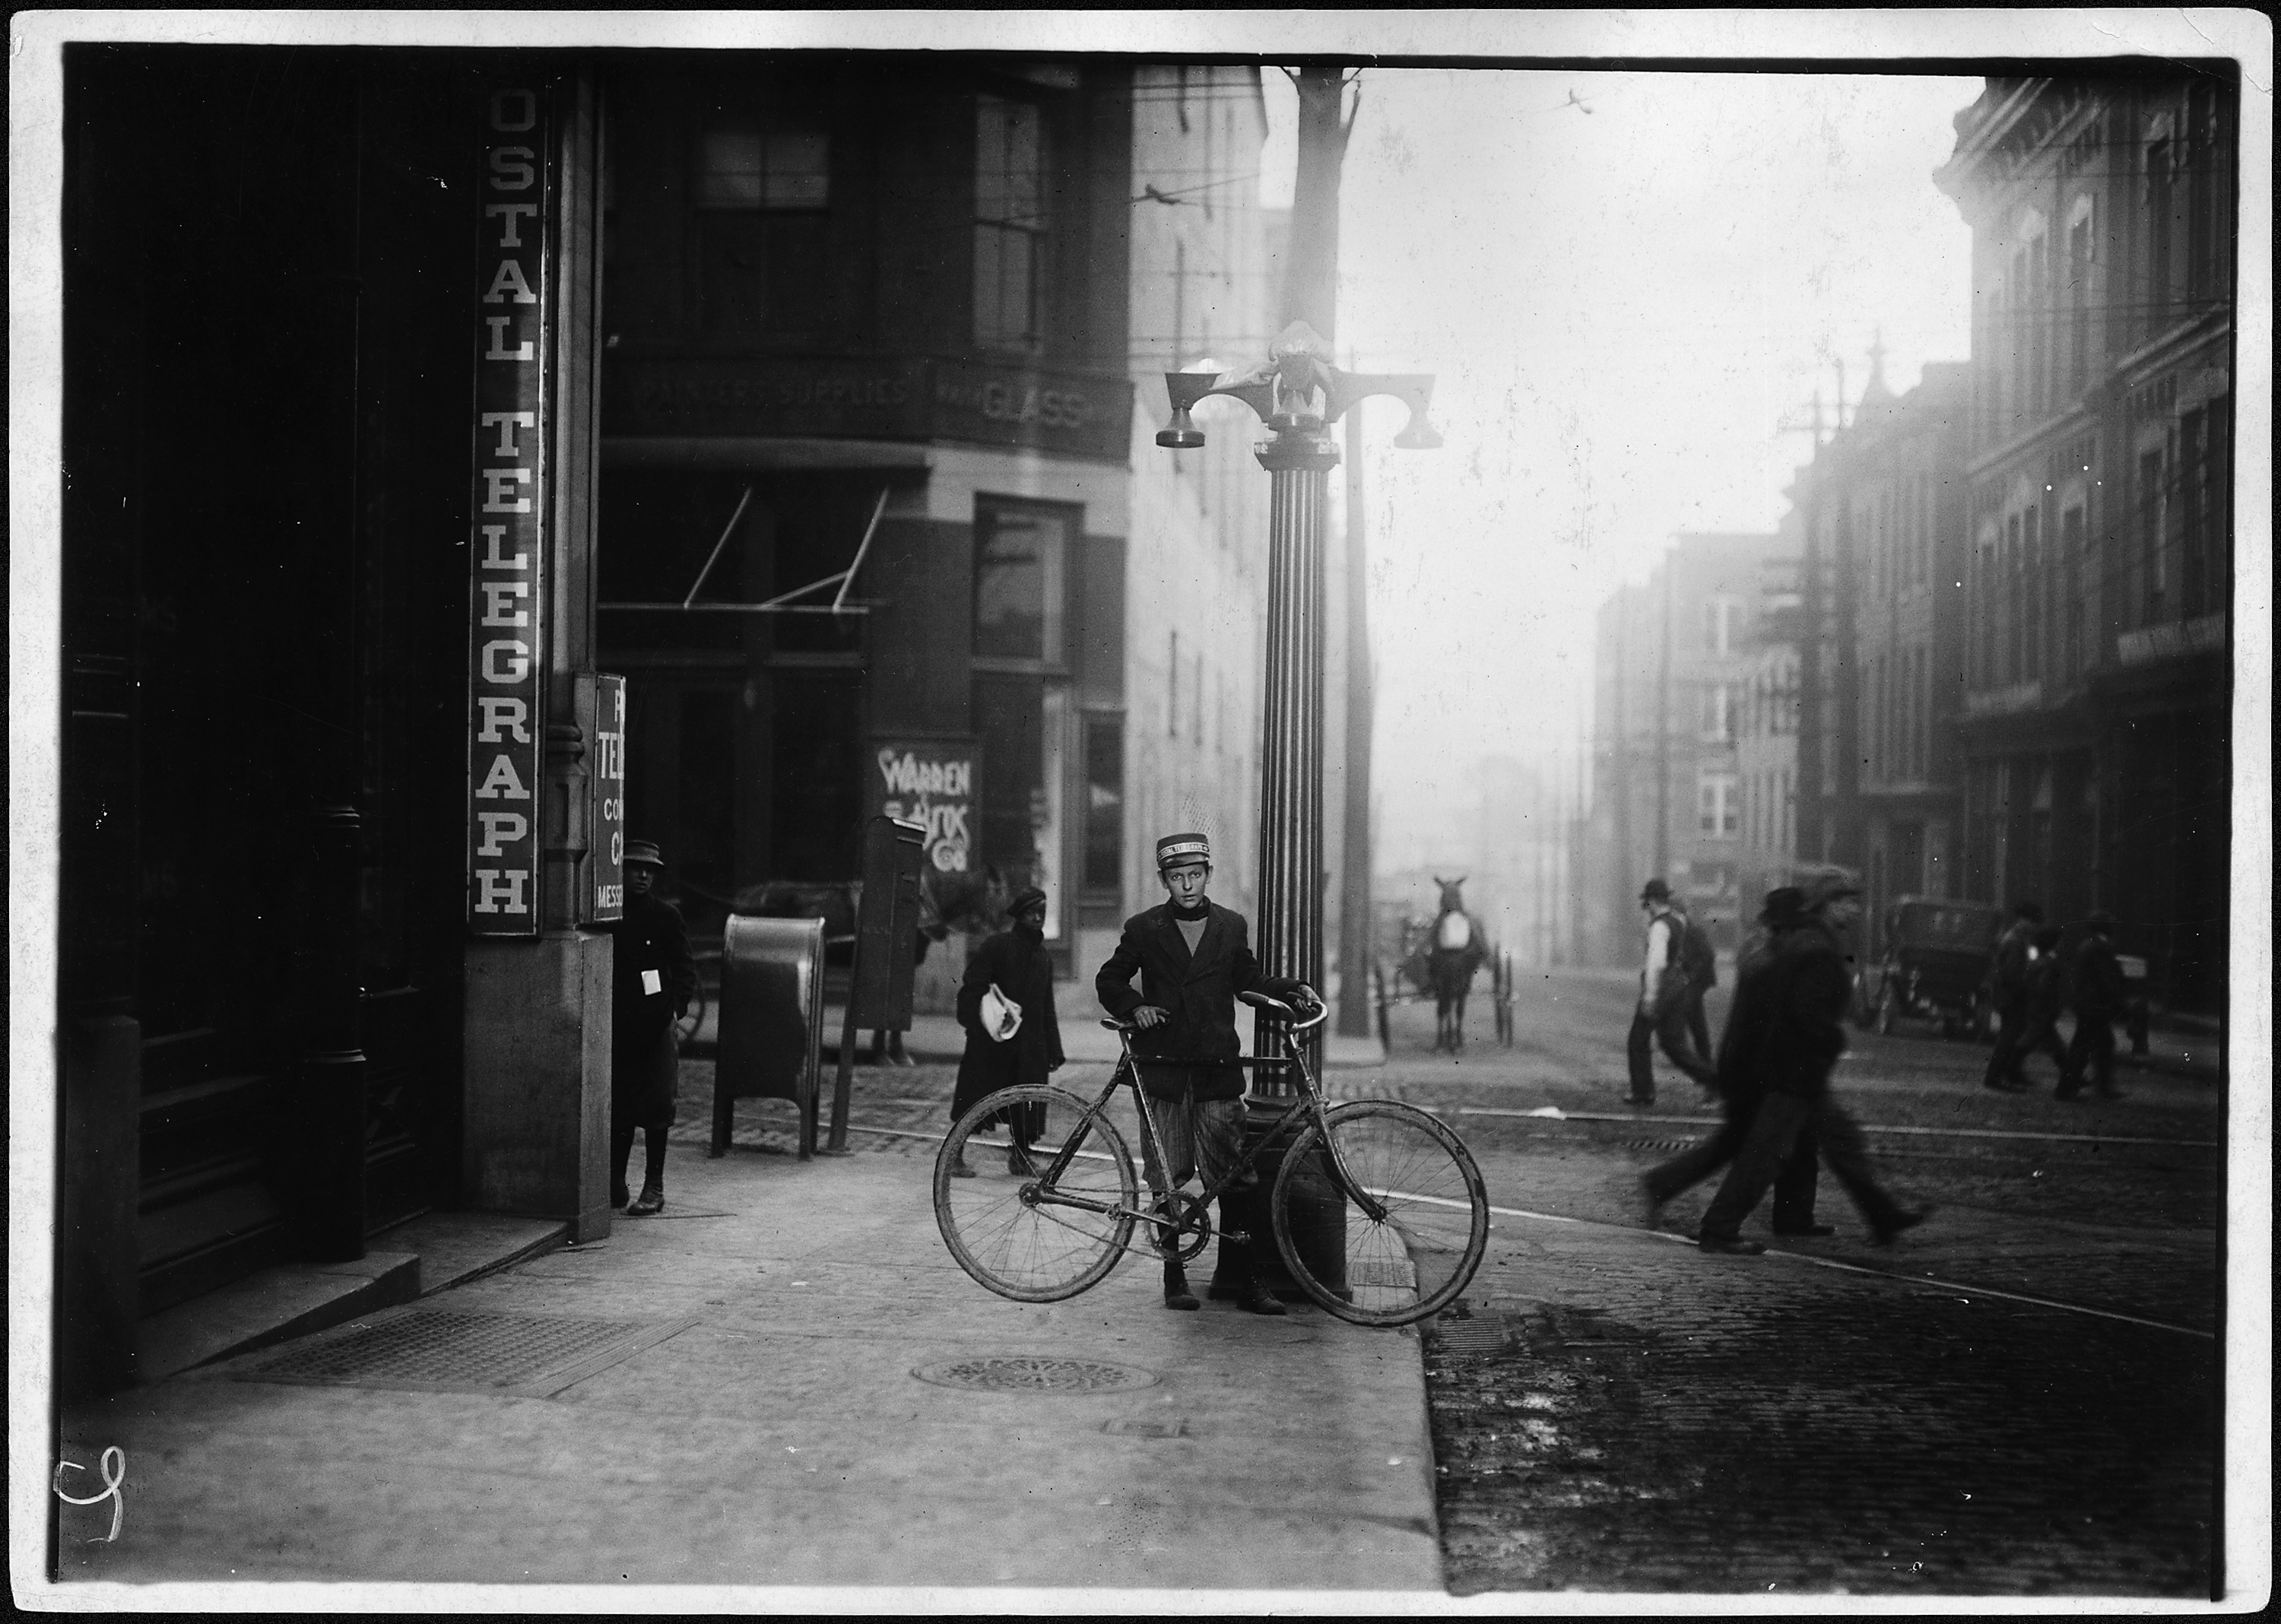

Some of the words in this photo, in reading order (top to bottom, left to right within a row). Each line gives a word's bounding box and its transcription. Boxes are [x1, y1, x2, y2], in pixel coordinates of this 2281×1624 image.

[777, 376, 908, 406] SUPPLIES
[982, 381, 1086, 429] GLASS
[474, 411, 534, 914] TELEGRAPH
[877, 747, 970, 795] WARREN
